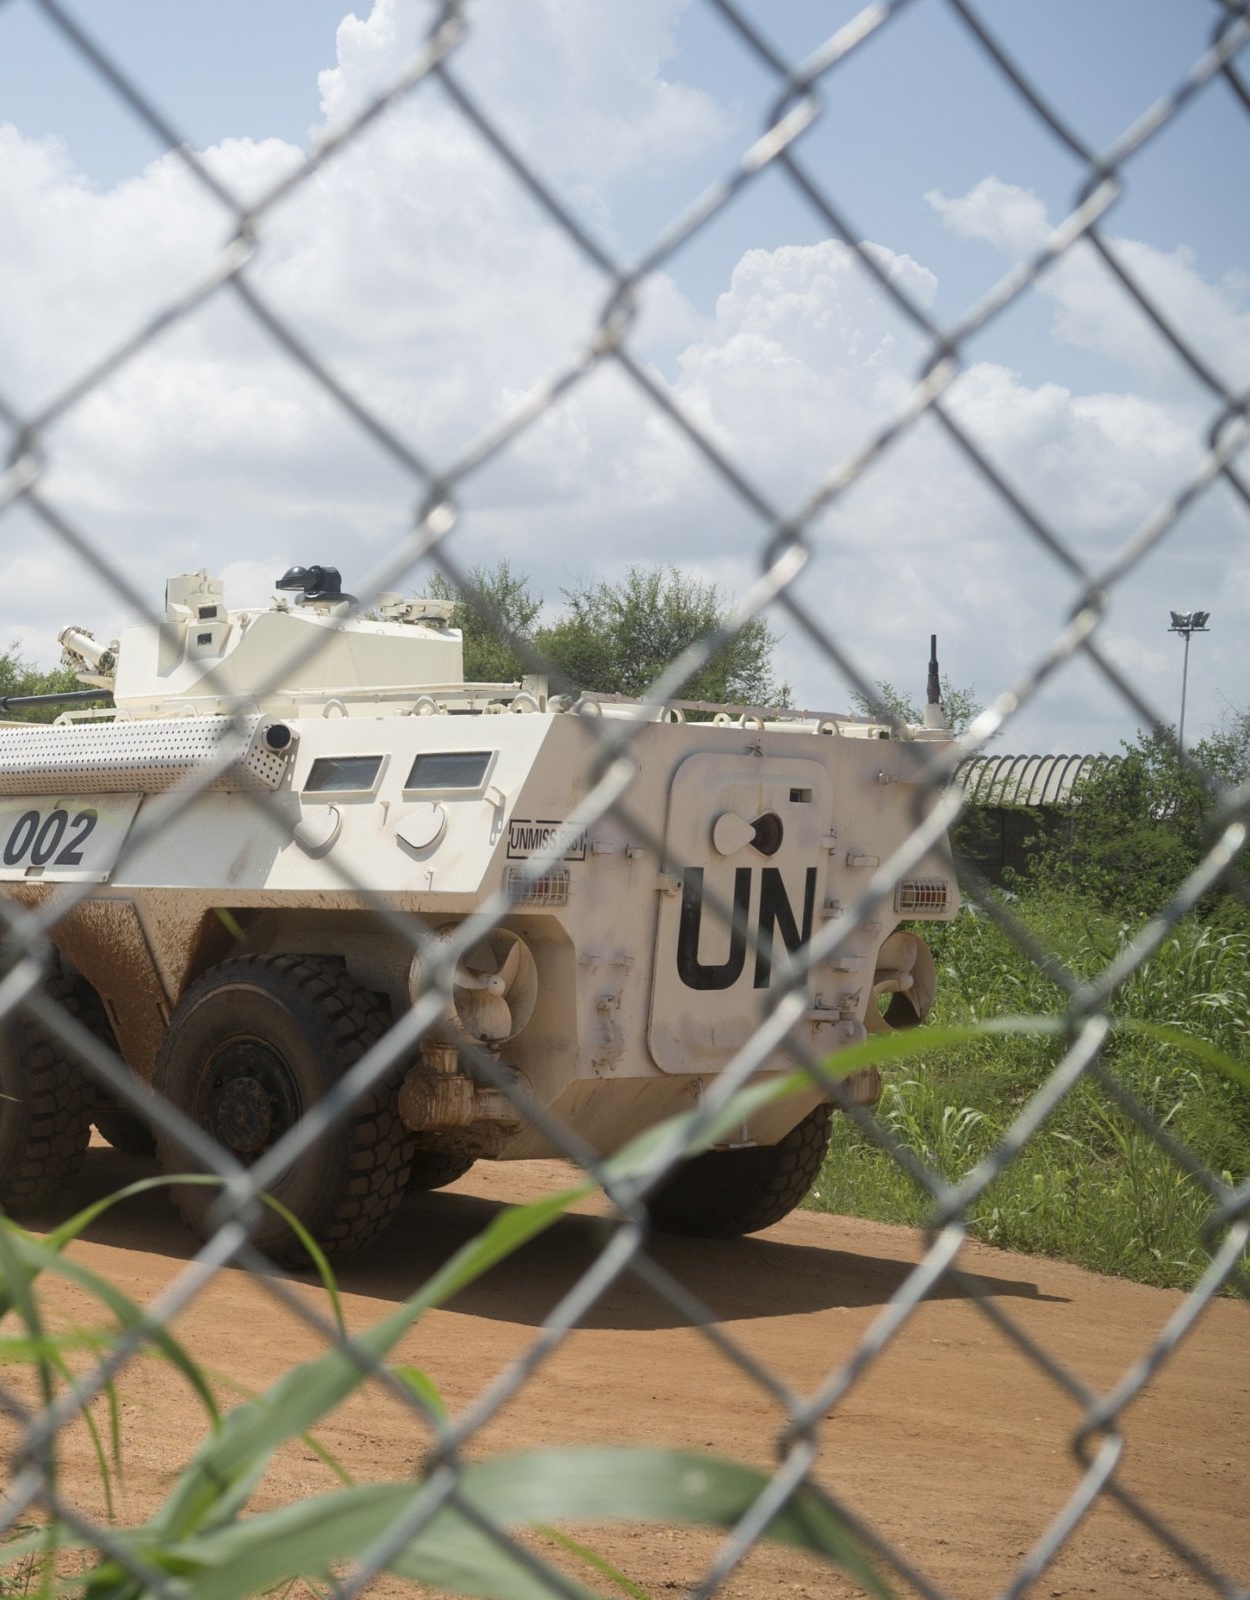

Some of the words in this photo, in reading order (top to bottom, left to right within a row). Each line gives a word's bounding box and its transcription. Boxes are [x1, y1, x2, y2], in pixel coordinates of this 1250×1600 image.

[3, 808, 99, 866] 002
[510, 827, 557, 851] UNMISS
[676, 866, 818, 991] UN
